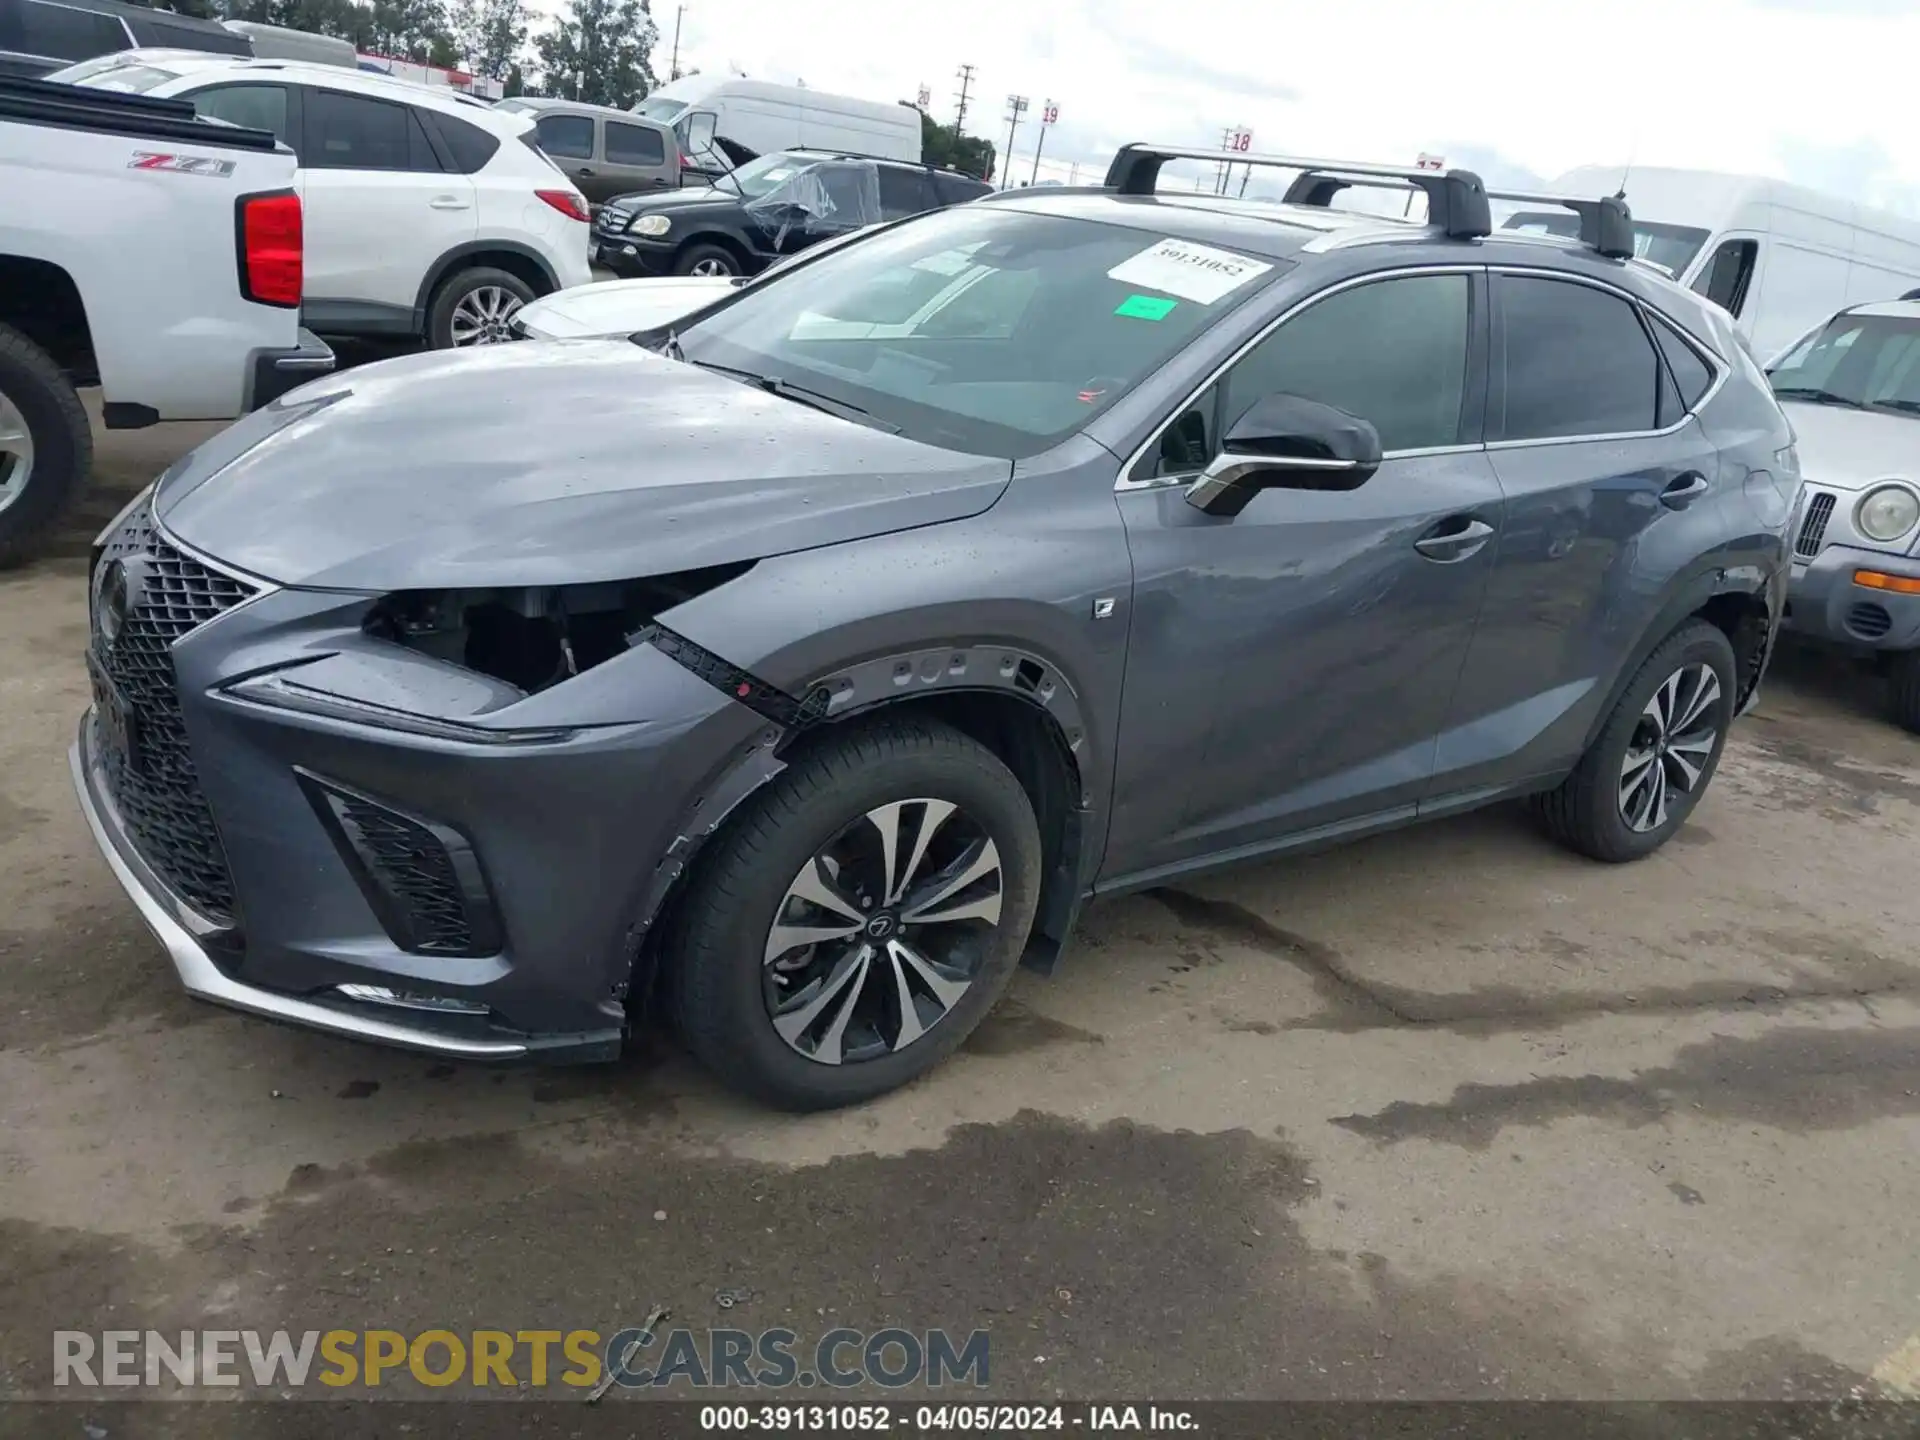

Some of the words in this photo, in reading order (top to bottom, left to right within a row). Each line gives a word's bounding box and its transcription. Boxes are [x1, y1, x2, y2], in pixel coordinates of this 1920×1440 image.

[1043, 107, 1058, 123] 19
[1231, 133, 1250, 151] 18
[127, 149, 237, 179] Z71
[1153, 248, 1244, 277] 39131052
